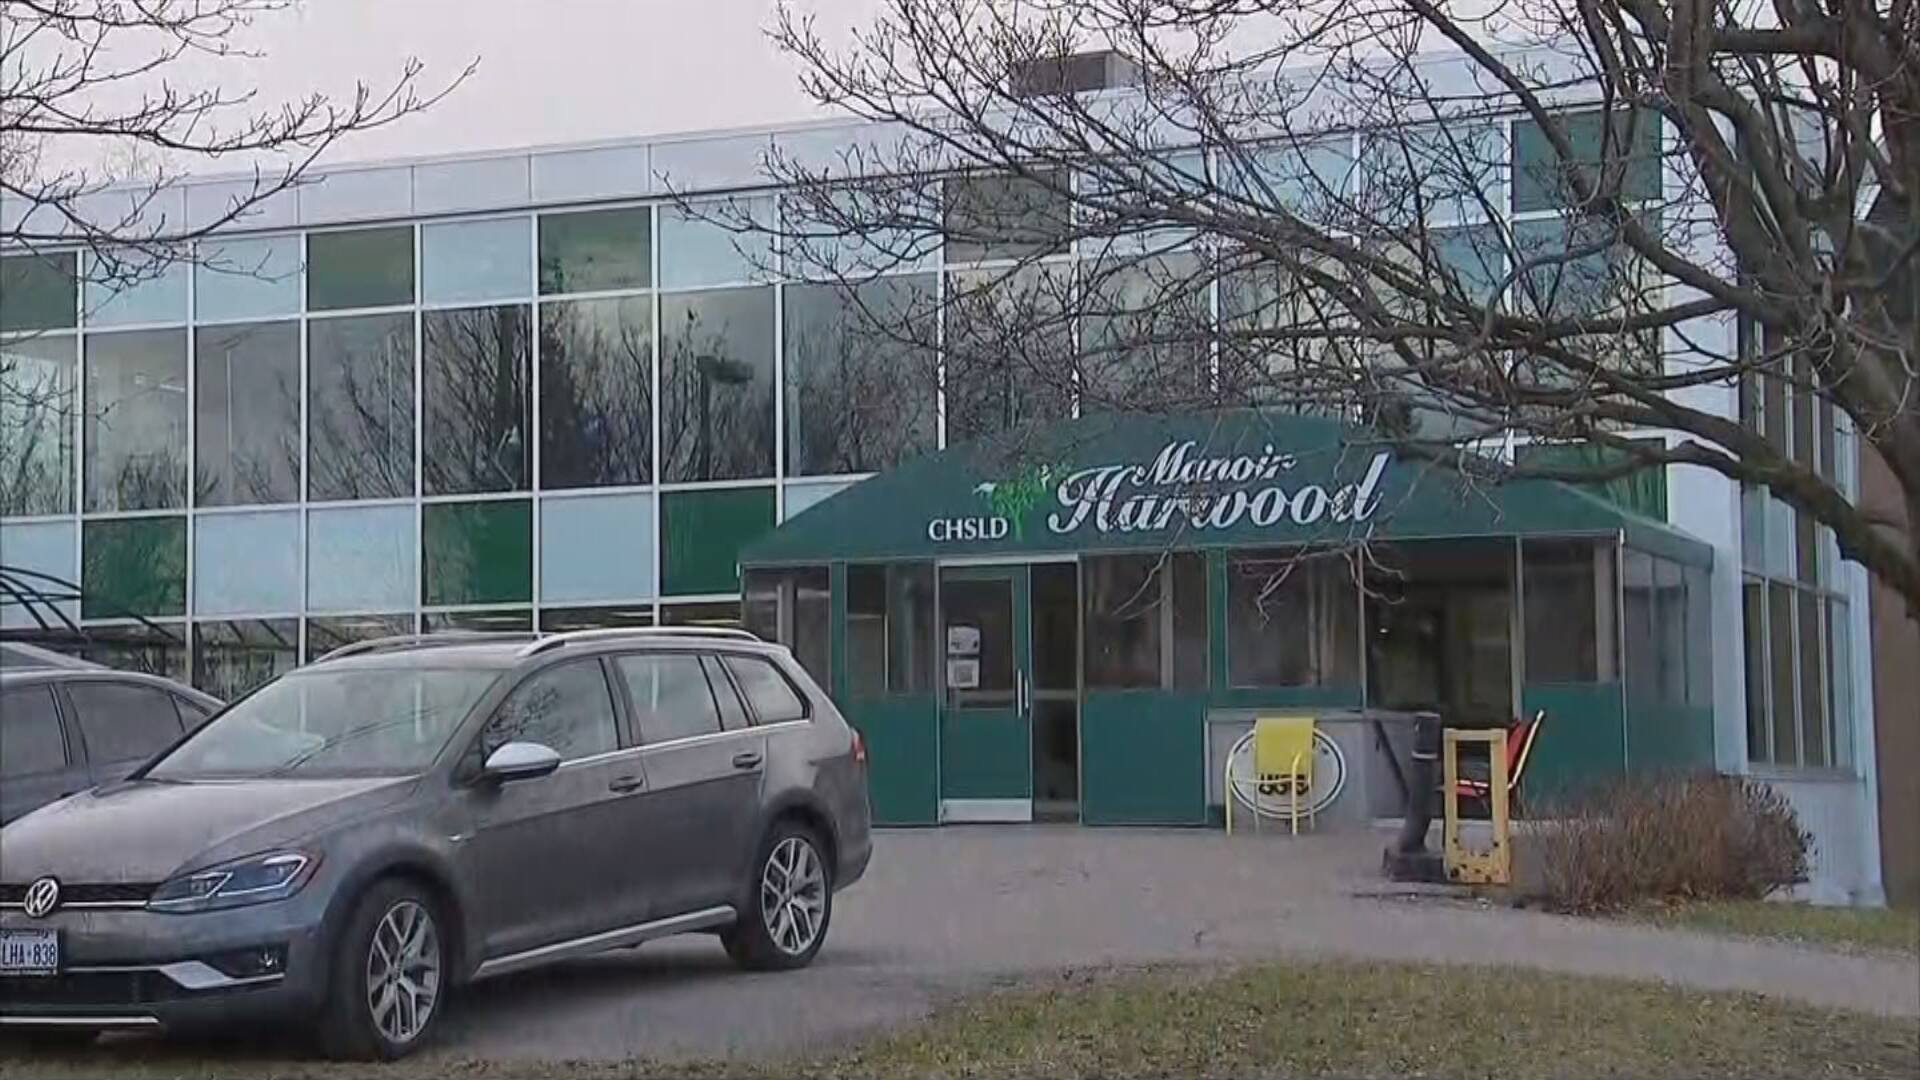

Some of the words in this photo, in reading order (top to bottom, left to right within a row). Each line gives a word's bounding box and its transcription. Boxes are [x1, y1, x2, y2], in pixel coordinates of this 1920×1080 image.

[1131, 440, 1297, 486] Manoir
[1047, 452, 1390, 533] Harwood
[928, 517, 1009, 541] CHSLD
